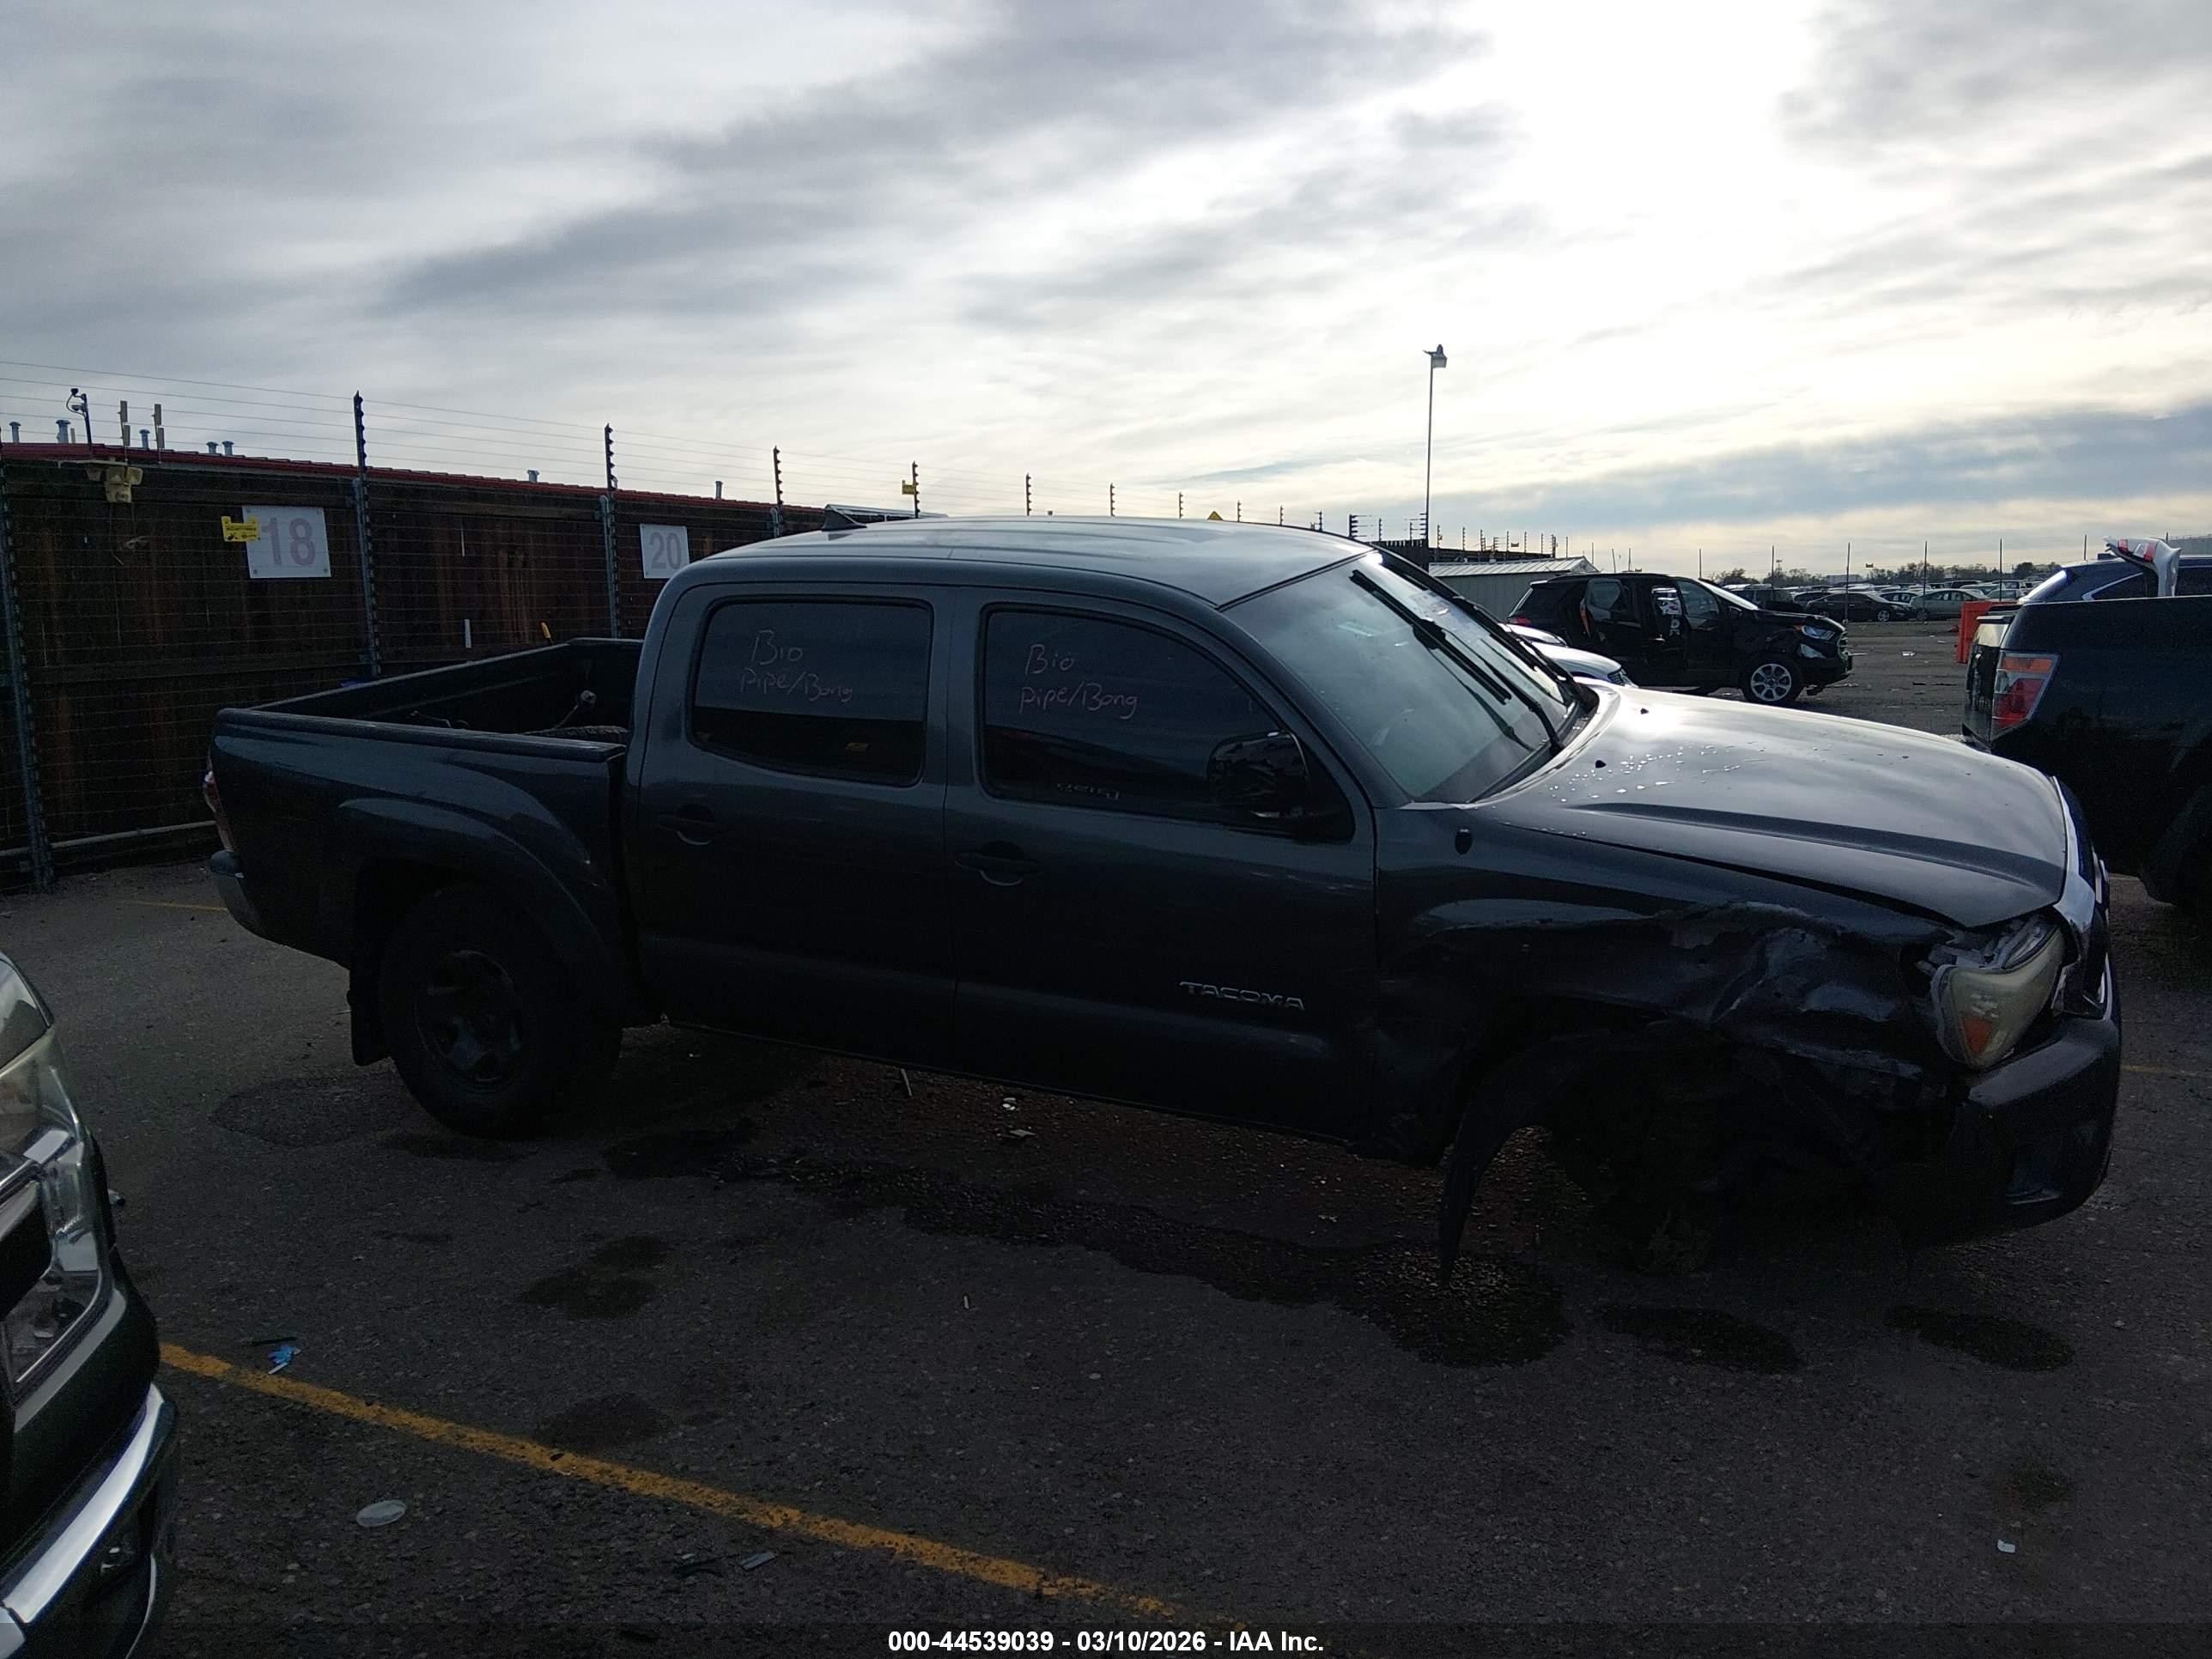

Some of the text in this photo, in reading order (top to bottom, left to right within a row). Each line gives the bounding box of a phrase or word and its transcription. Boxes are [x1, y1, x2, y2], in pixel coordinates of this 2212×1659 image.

[261, 517, 316, 567] 18
[650, 532, 682, 569] 20
[1024, 644, 1075, 675] Bio
[1179, 981, 1305, 1011] TACOMA
